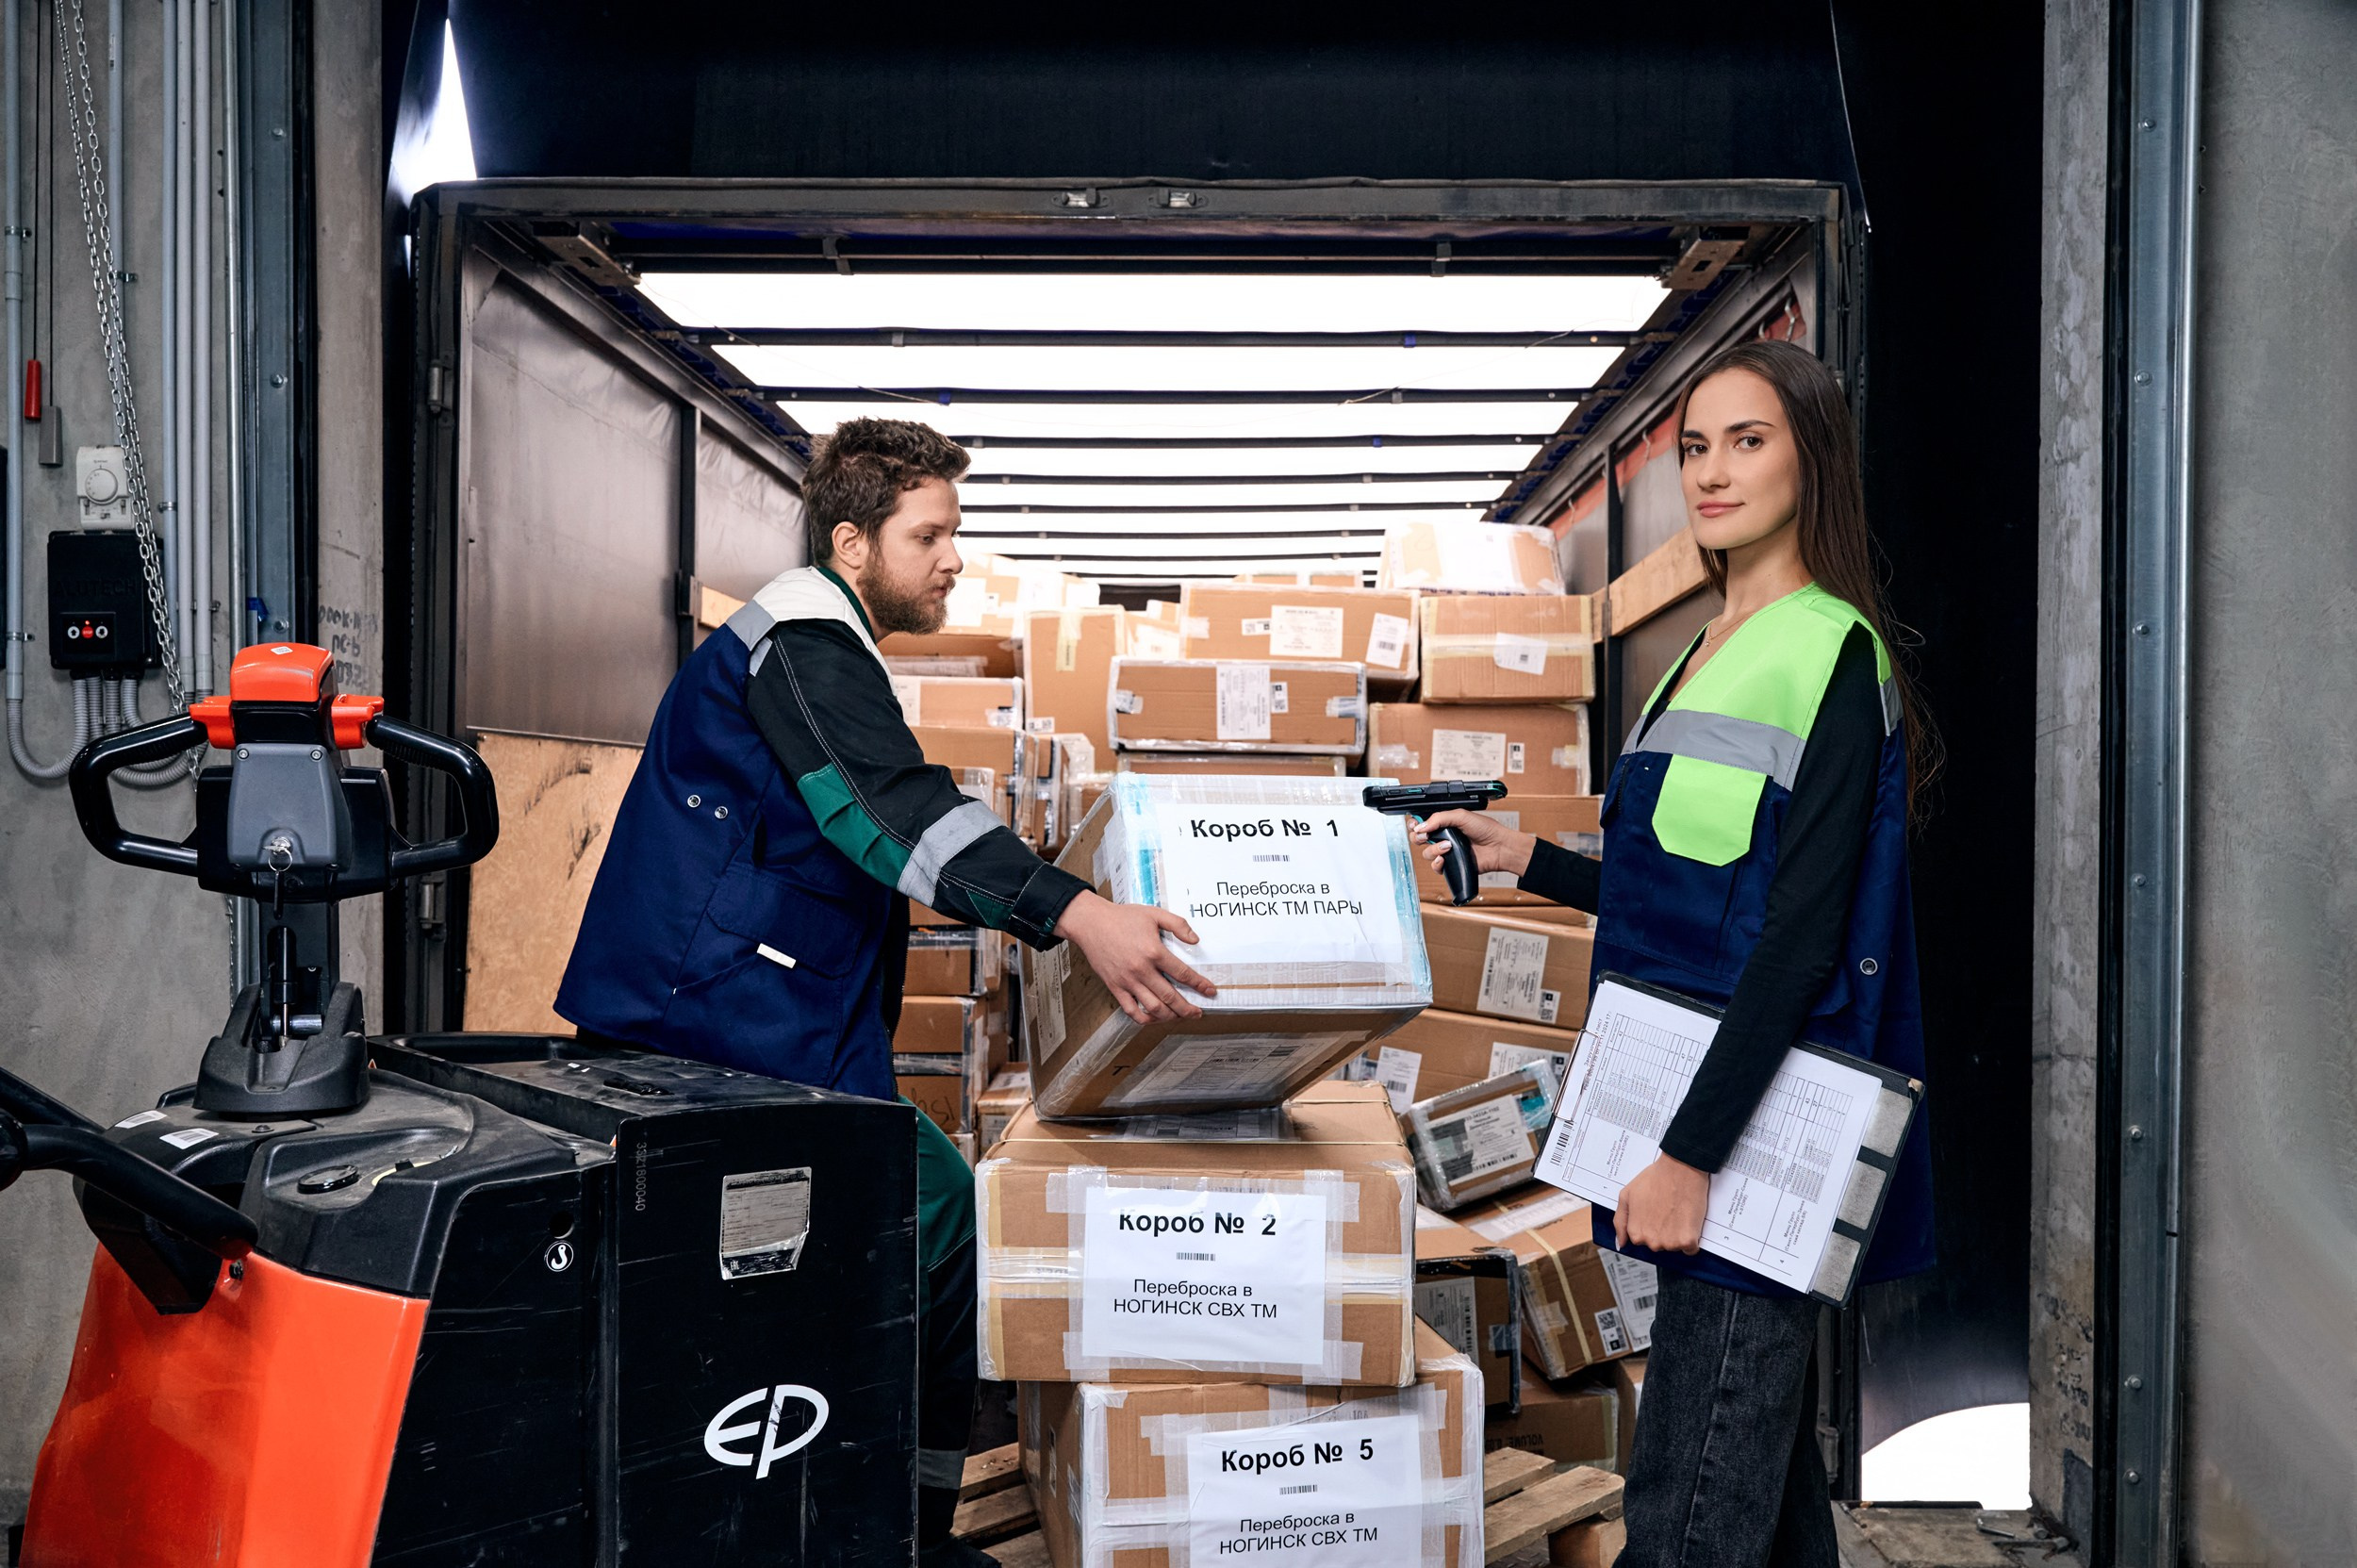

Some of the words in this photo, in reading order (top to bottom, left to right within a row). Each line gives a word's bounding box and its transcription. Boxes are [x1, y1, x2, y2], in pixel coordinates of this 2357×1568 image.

[1190, 818, 1275, 843] Короб
[1281, 819, 1311, 837] №
[1327, 819, 1339, 837] 1
[1216, 881, 1316, 899] Переброска
[1321, 883, 1330, 895] в
[1190, 900, 1278, 917] НОГИНСК
[1282, 901, 1309, 916] ТМ
[1313, 900, 1363, 916] ПАРЫ
[1119, 1213, 1205, 1238] Короб
[1214, 1212, 1244, 1234] №
[1261, 1214, 1277, 1236] 2
[1134, 1279, 1237, 1298] Переброска
[1243, 1286, 1253, 1297] в
[1113, 1298, 1203, 1316] НОГИНСК
[1208, 1301, 1245, 1318] СВХ
[1250, 1303, 1277, 1318] ТМ
[1222, 1444, 1305, 1476] Короб
[1313, 1442, 1343, 1465] №
[1360, 1438, 1374, 1461] 5
[1240, 1513, 1340, 1534] Переброска
[1345, 1512, 1355, 1524] в
[1220, 1533, 1308, 1555] НОГИНСК
[1311, 1529, 1347, 1547] СВХ
[1352, 1527, 1377, 1543] ТМ
